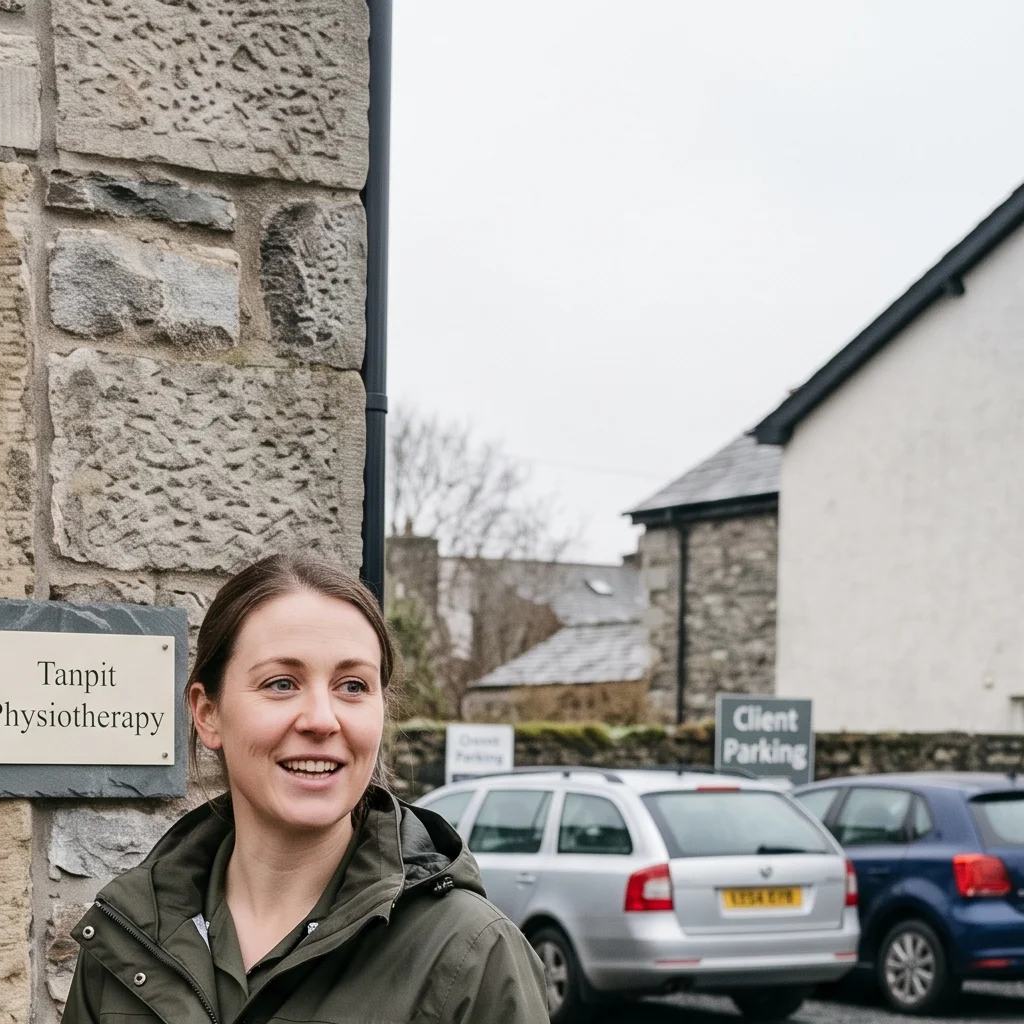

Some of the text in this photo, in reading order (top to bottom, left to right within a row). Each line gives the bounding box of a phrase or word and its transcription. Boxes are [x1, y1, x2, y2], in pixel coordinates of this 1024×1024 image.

[37, 661, 117, 693] Tanpit
[733, 705, 799, 732] Client
[723, 737, 807, 770] Parking
